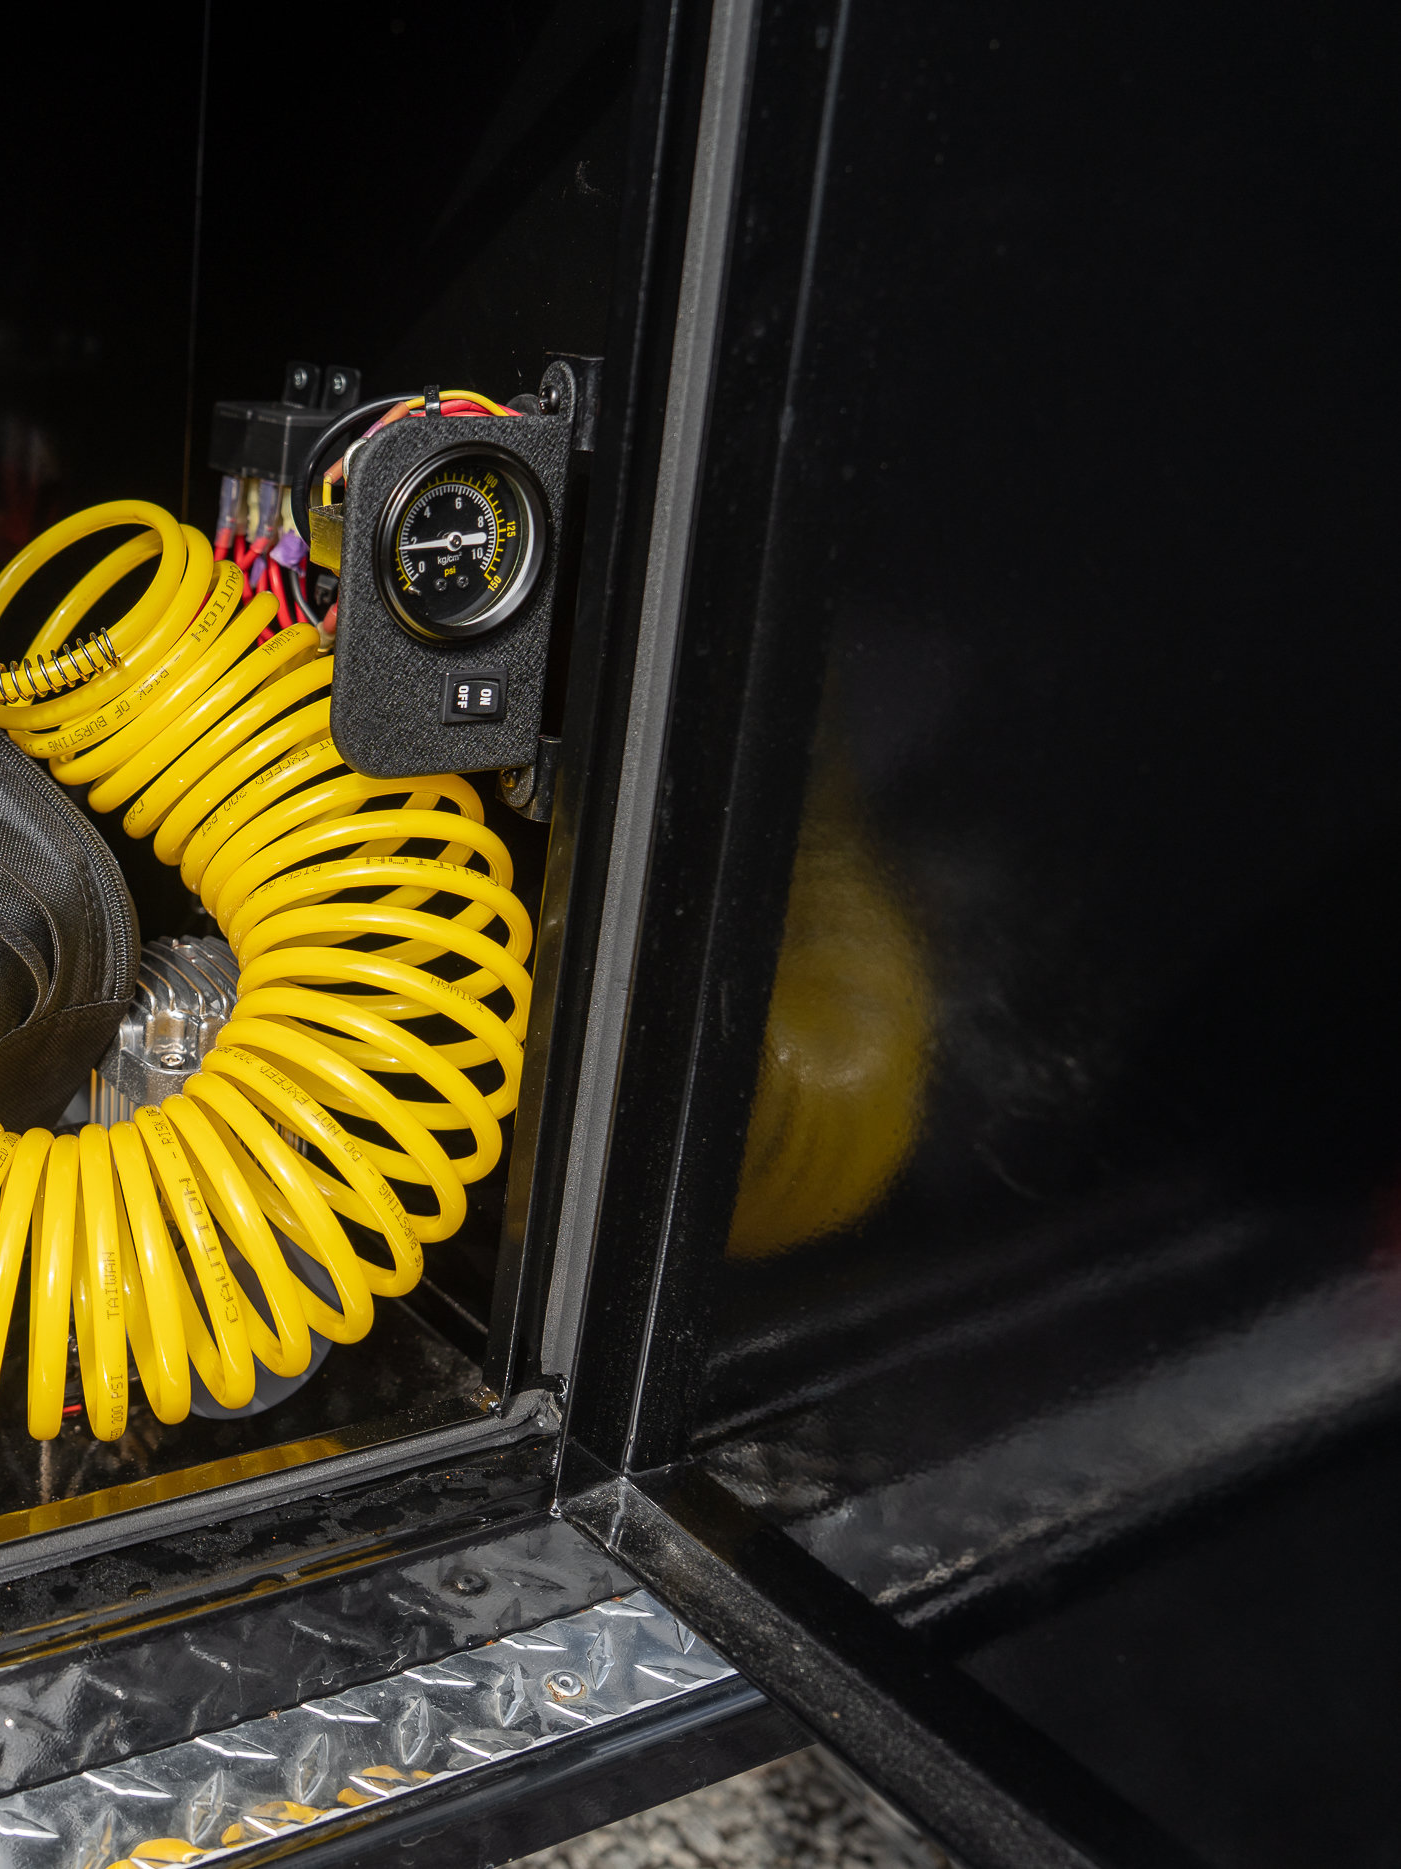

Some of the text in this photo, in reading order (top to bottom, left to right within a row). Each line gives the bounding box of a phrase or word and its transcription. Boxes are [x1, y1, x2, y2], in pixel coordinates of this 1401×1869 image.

[484, 472, 498, 488] 100
[423, 506, 431, 518] 4
[455, 497, 462, 510] 6
[477, 515, 484, 528] 8
[506, 520, 516, 538] 125
[471, 547, 483, 560] 10
[418, 560, 426, 573] 0
[444, 565, 456, 577] psi
[487, 575, 502, 592] 150
[191, 564, 241, 642] CAUTION
[262, 627, 301, 656] TAIWAN
[134, 666, 170, 701] RISK
[457, 685, 470, 709] OFF
[479, 688, 492, 706] ON
[114, 699, 131, 719] OF
[48, 715, 108, 752] BURSTING
[430, 976, 484, 1013] TAIWAN
[260, 1066, 311, 1106] EXCEED
[152, 1120, 174, 1145] RISK
[312, 1110, 341, 1137] NOT
[343, 1140, 363, 1162] DO
[378, 1183, 419, 1251] BURSTING
[179, 1177, 239, 1324] CAUTION
[102, 1251, 120, 1320] TAIWAN
[111, 1405, 123, 1424] 200
